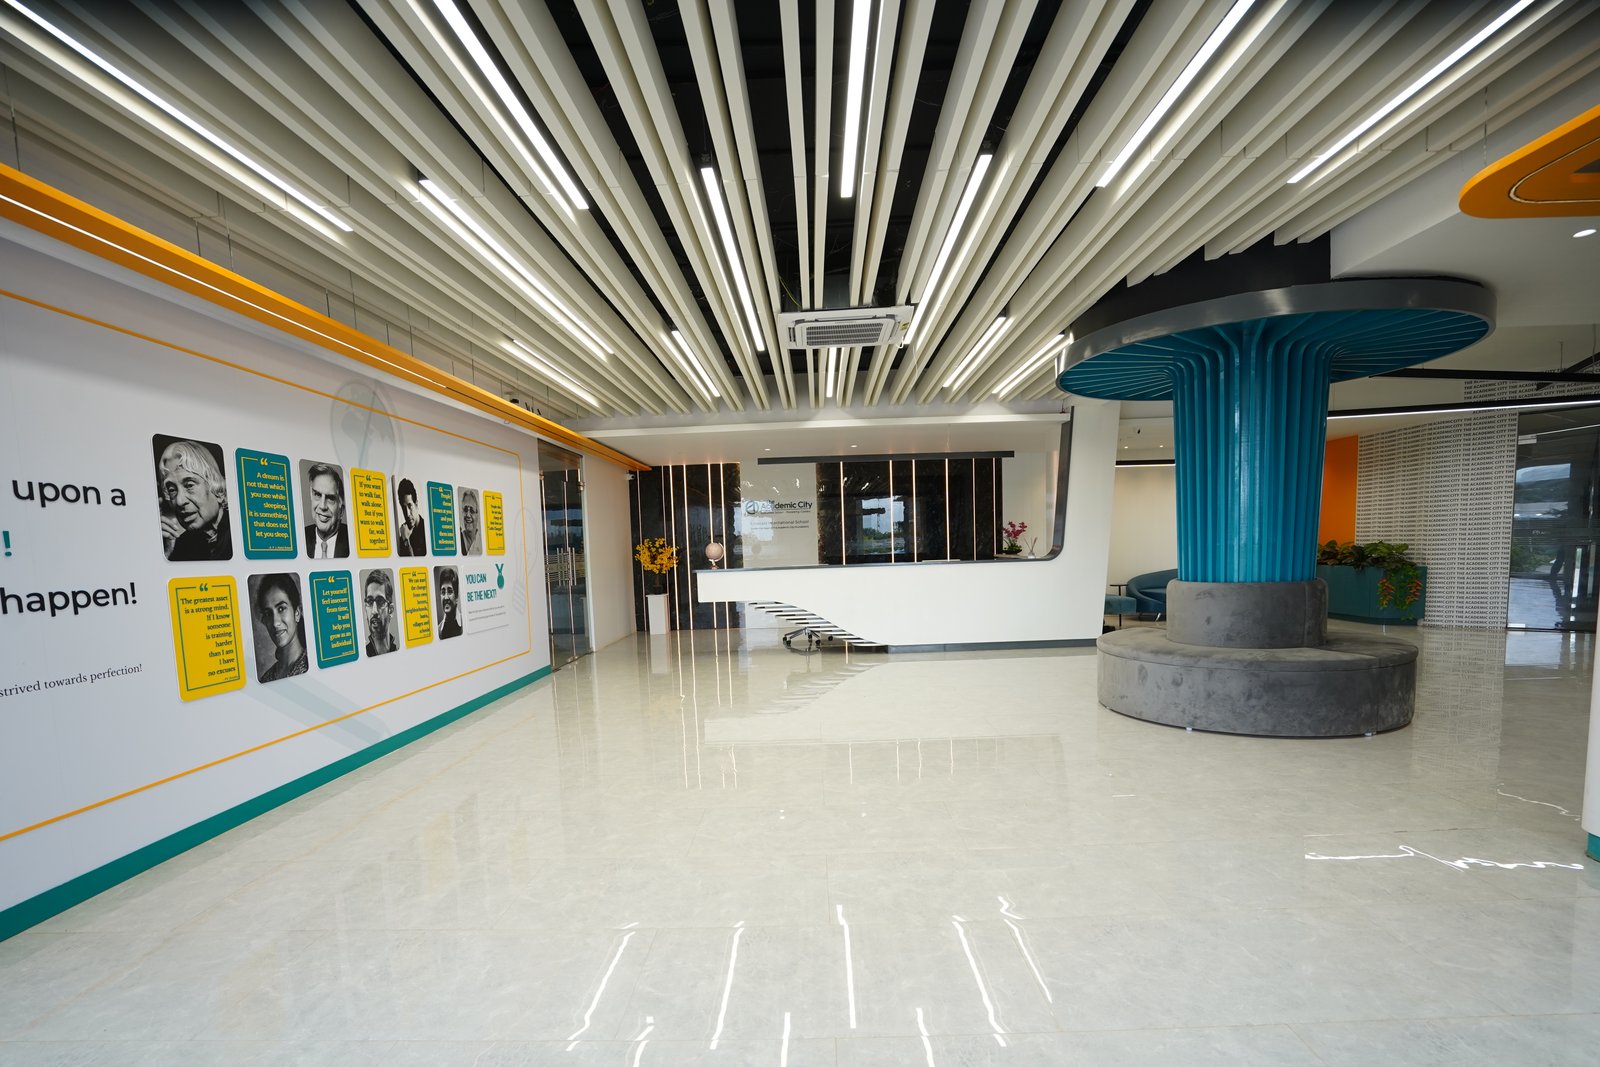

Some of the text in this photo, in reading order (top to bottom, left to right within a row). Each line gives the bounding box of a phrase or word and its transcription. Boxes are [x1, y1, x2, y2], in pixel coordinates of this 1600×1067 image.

[12, 480, 126, 507] upon a
[264, 502, 287, 510] sleeping,
[260, 511, 288, 520] something
[466, 574, 486, 584] YOU CAN
[330, 588, 347, 596] yourself
[467, 592, 473, 602] BE
[474, 591, 483, 600] THE
[0, 582, 137, 617] happen!
[194, 596, 214, 605] greatest
[211, 630, 232, 639] training
[331, 639, 352, 648] individual
[216, 666, 235, 676] excuses
[0, 664, 143, 698] strived towards perfection!
